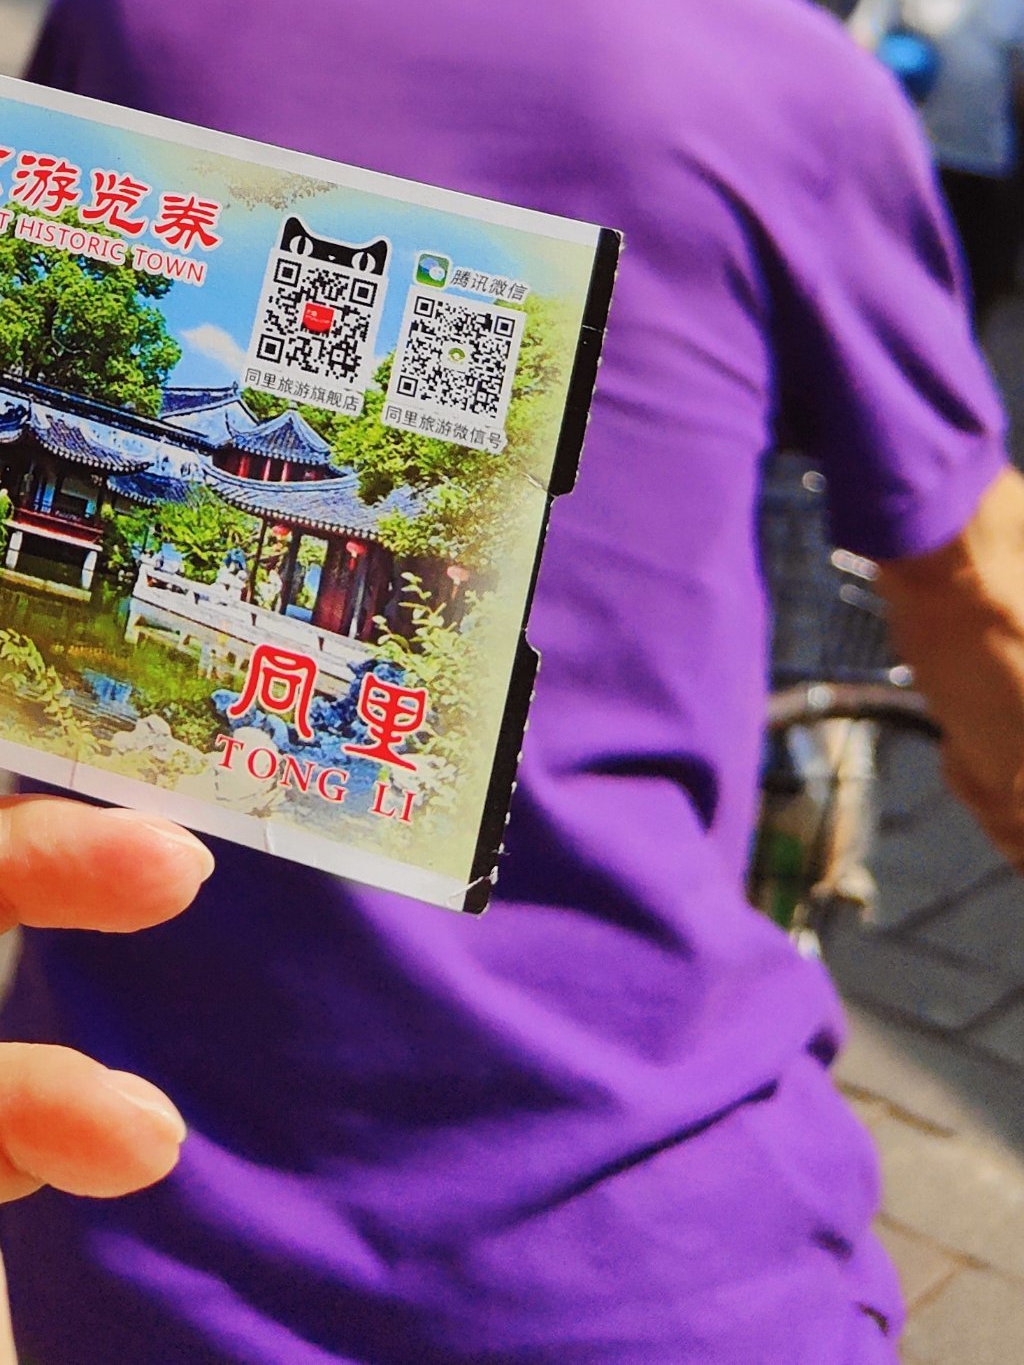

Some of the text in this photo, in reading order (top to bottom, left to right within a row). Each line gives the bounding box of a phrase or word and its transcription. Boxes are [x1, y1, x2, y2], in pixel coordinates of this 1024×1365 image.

[18, 218, 125, 261] HISTORIC
[133, 248, 205, 282] TOWN
[450, 269, 528, 301] 腾讯微信
[245, 367, 359, 412] 同里旅游旗舰店
[385, 405, 502, 449] 同里旅游微信号
[216, 734, 417, 823] TONG LI
